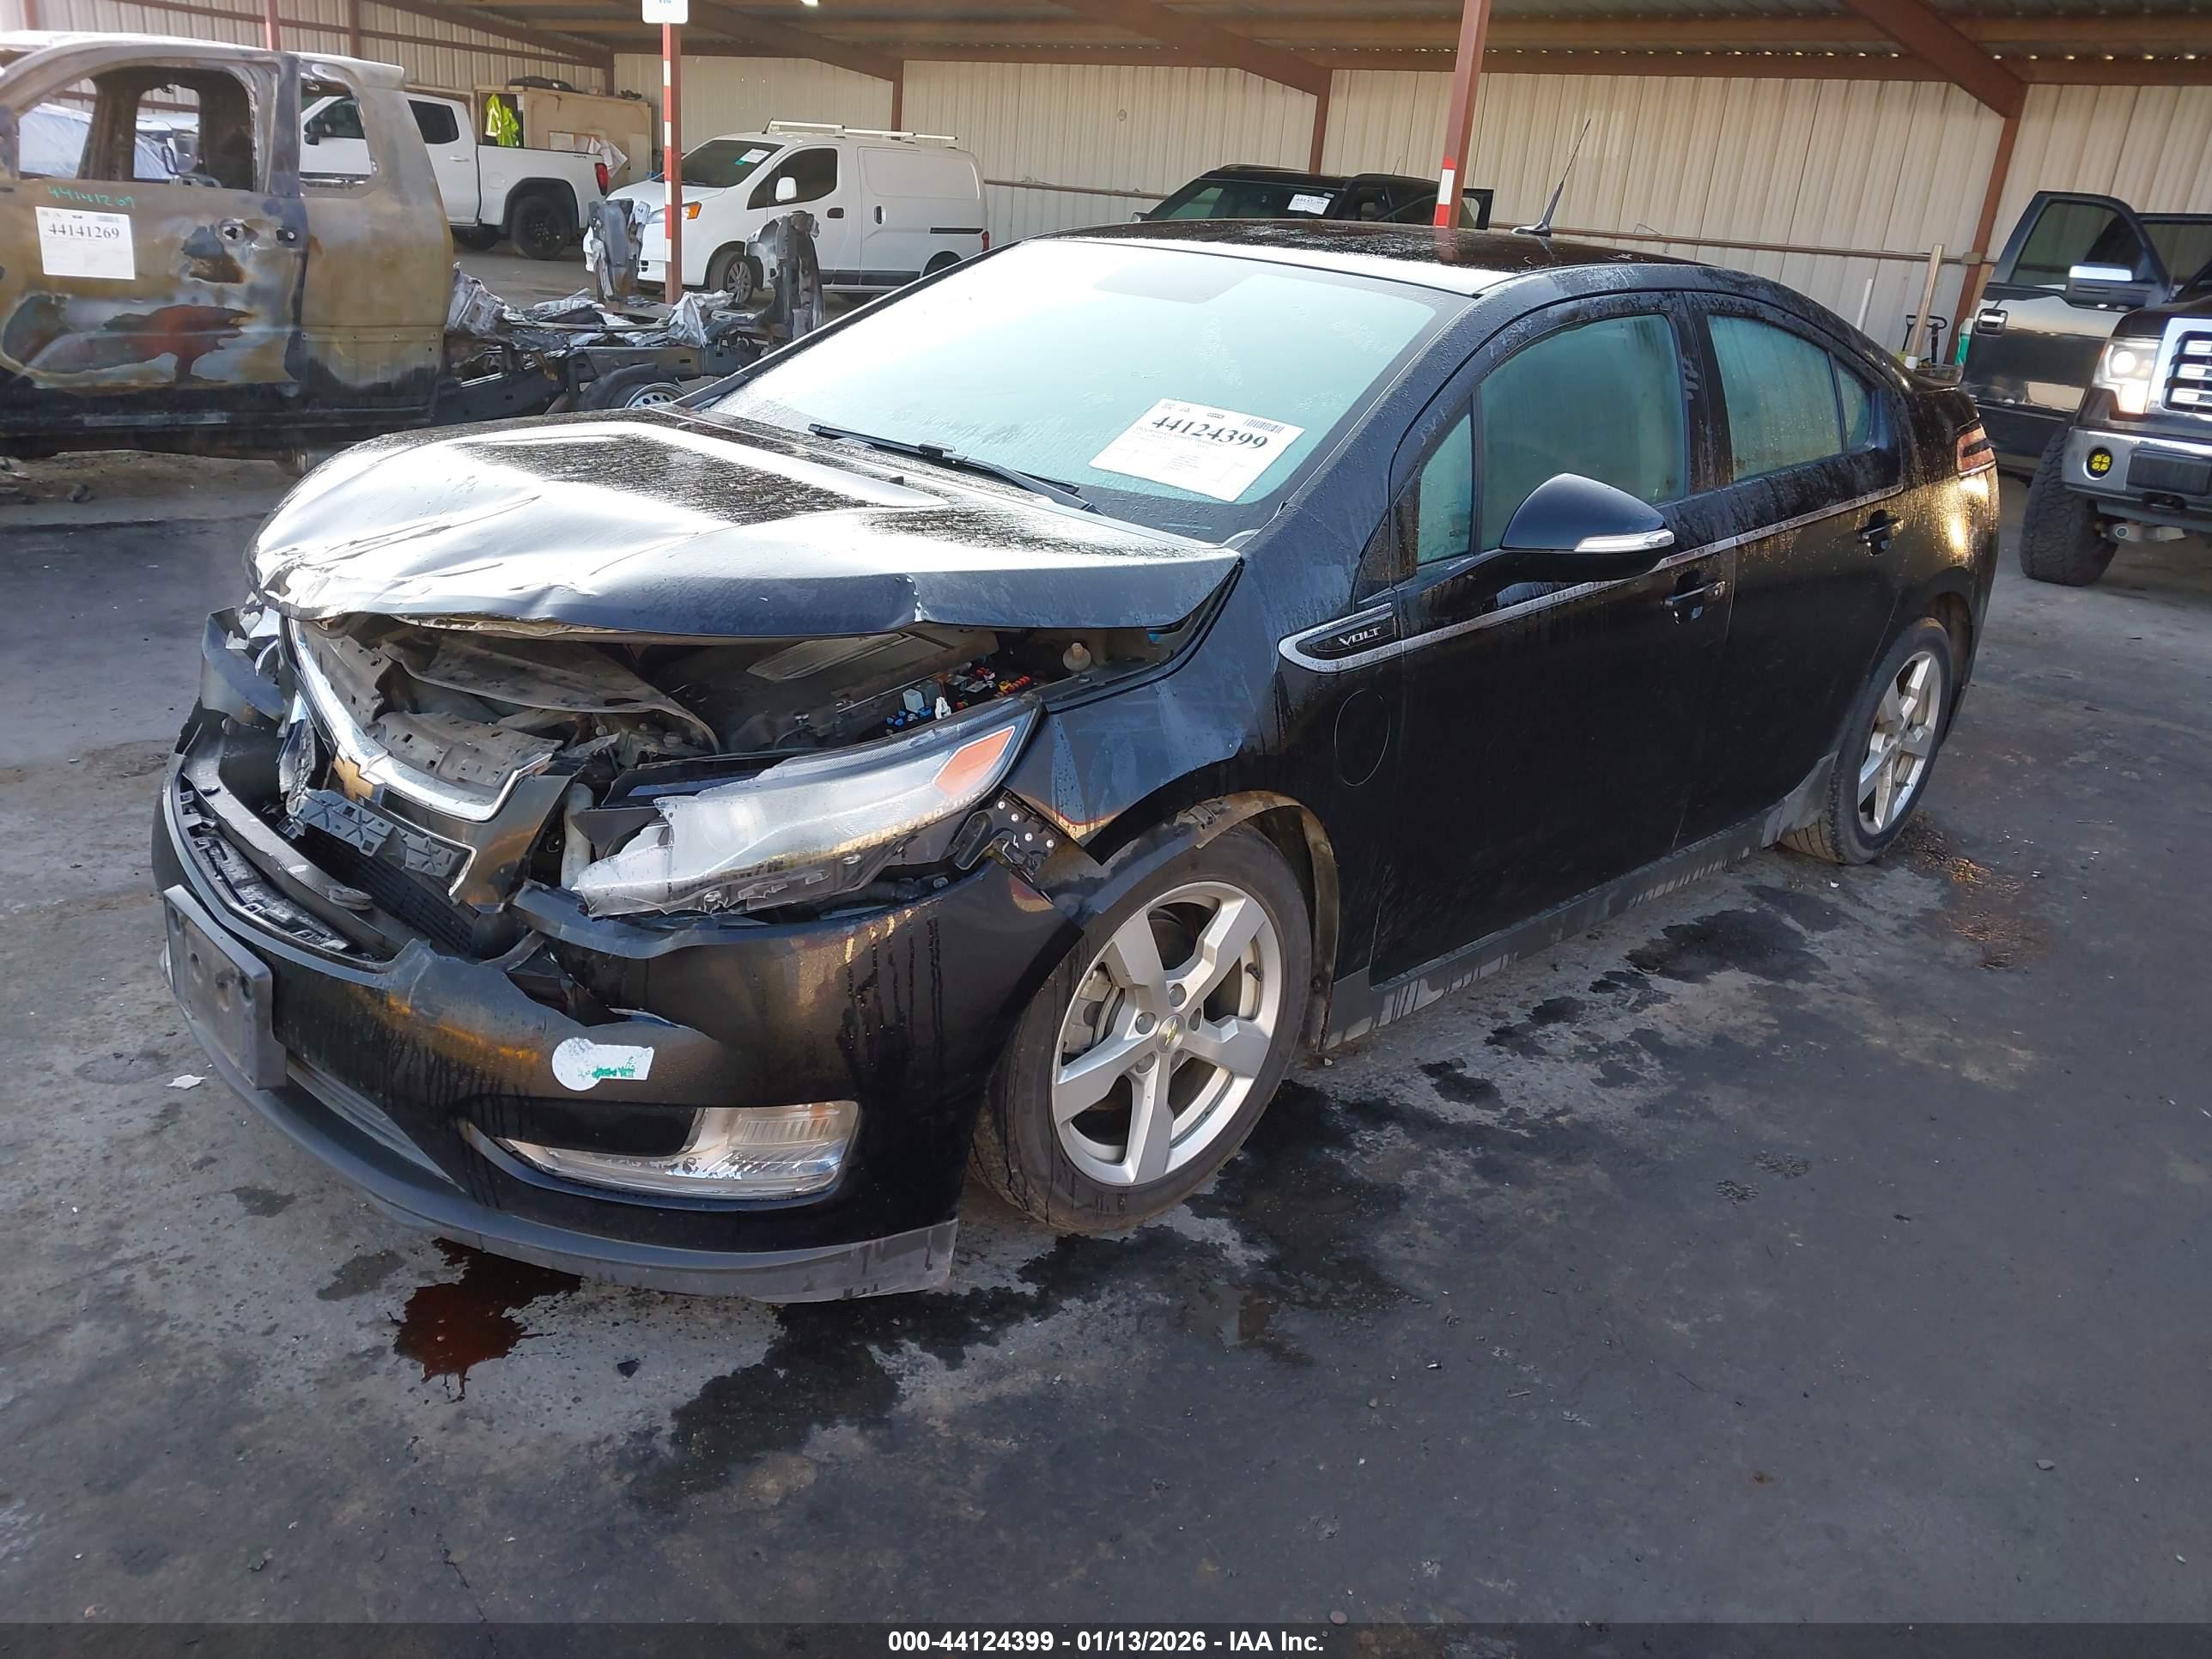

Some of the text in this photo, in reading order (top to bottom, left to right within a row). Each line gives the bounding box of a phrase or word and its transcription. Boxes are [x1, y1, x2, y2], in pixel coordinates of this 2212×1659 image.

[47, 186, 136, 209] 44141269
[48, 222, 119, 239] 44141269
[1152, 416, 1268, 449] 44124399
[1338, 627, 1381, 646] VOLT
